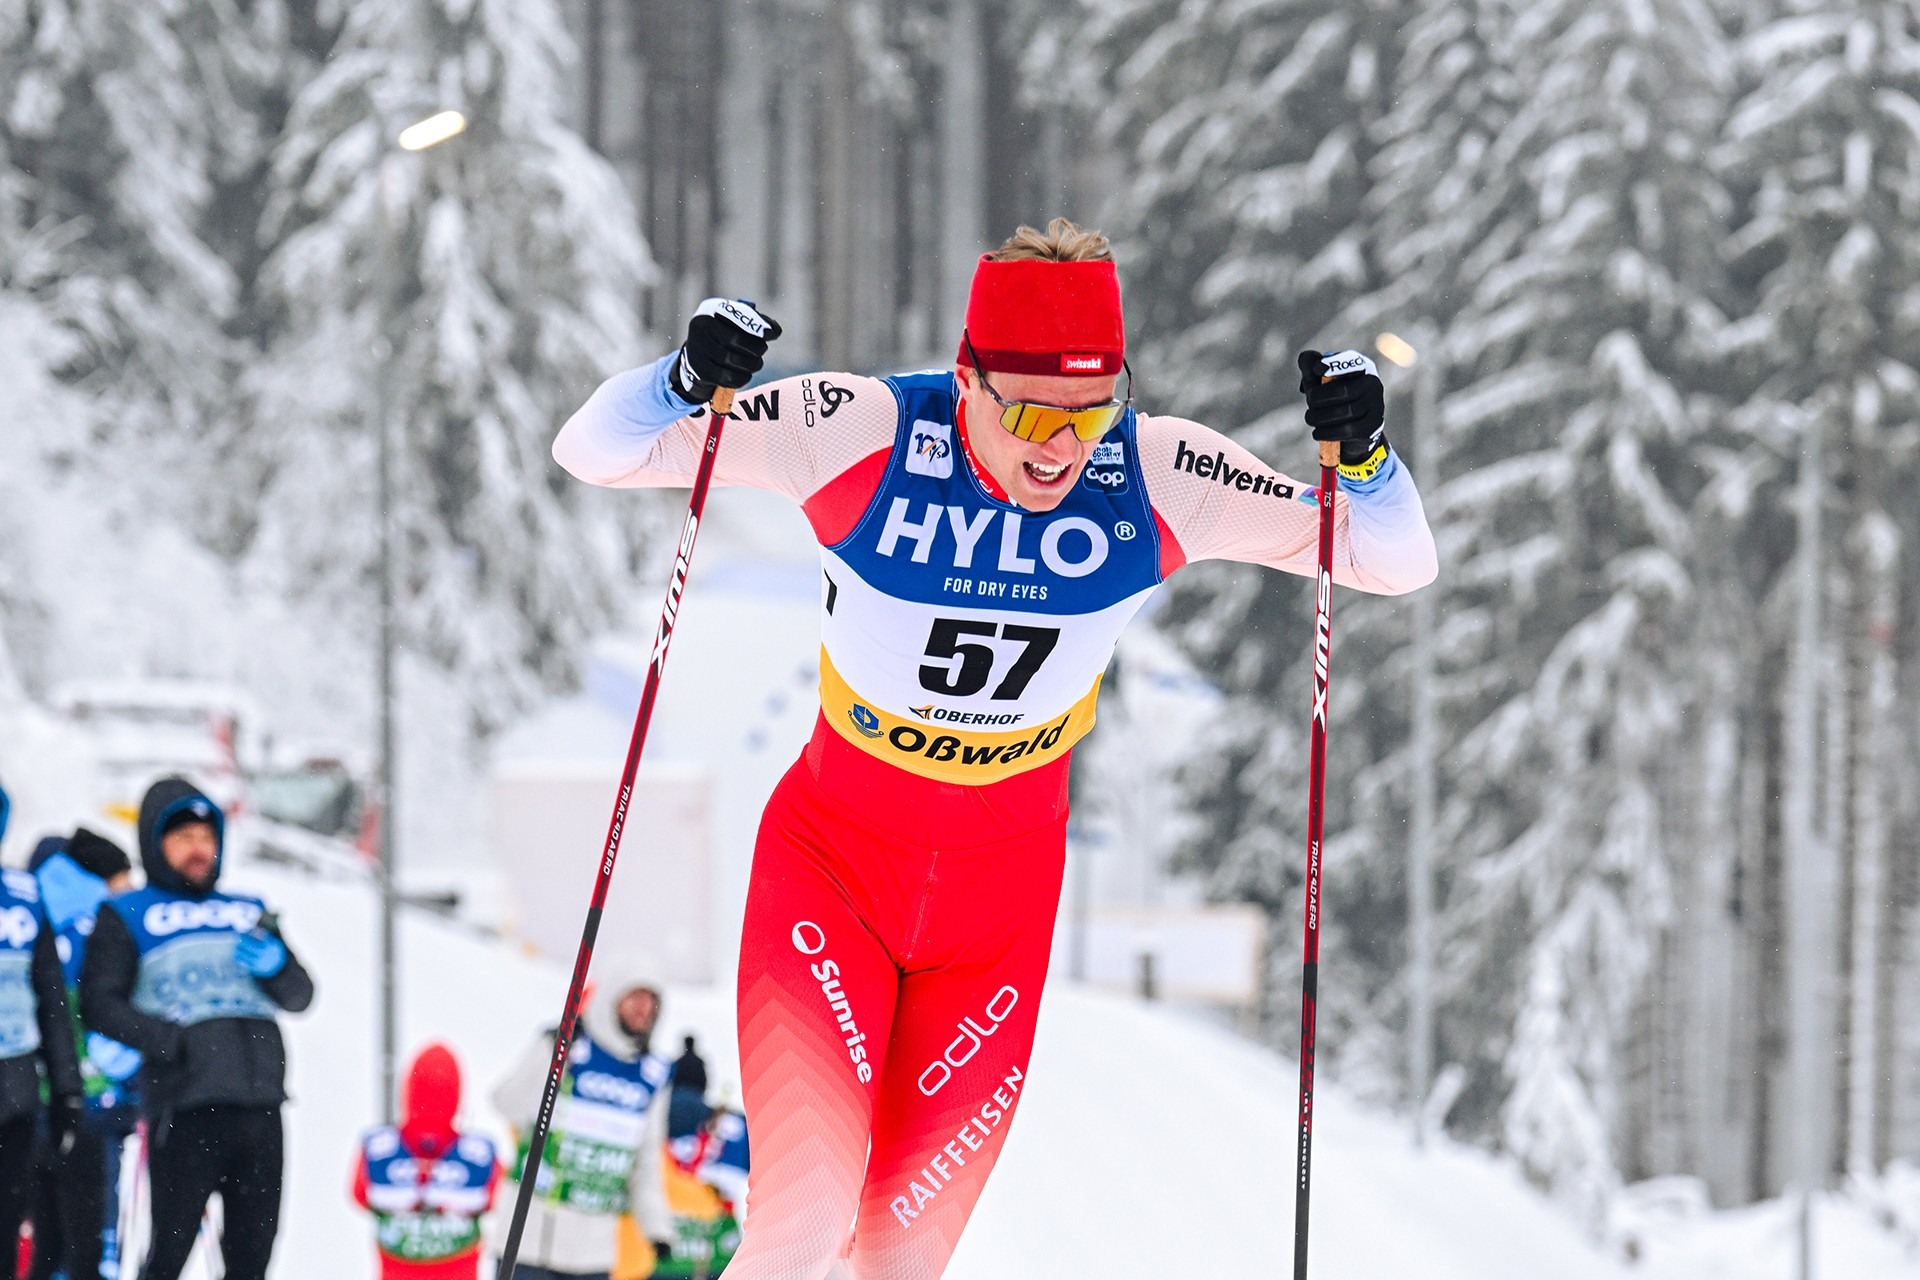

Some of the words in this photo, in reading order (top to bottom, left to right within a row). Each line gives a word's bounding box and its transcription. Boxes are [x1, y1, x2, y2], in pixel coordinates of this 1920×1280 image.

[706, 435, 717, 453] TCS
[1174, 440, 1294, 499] helvetia
[1324, 491, 1332, 508] TCS
[876, 496, 1109, 578] HYLO
[652, 508, 698, 679] SWIX
[943, 577, 972, 594] FOR
[977, 582, 1006, 598] DRY
[1012, 584, 1048, 600] EYES
[918, 617, 1061, 700] 57
[1313, 563, 1331, 733] SWIX
[888, 713, 1071, 765] Oßwald
[933, 708, 1025, 725] OBERHOF
[810, 959, 872, 1085] Sunrise
[889, 1065, 1024, 1229] RAIFFEISEN
